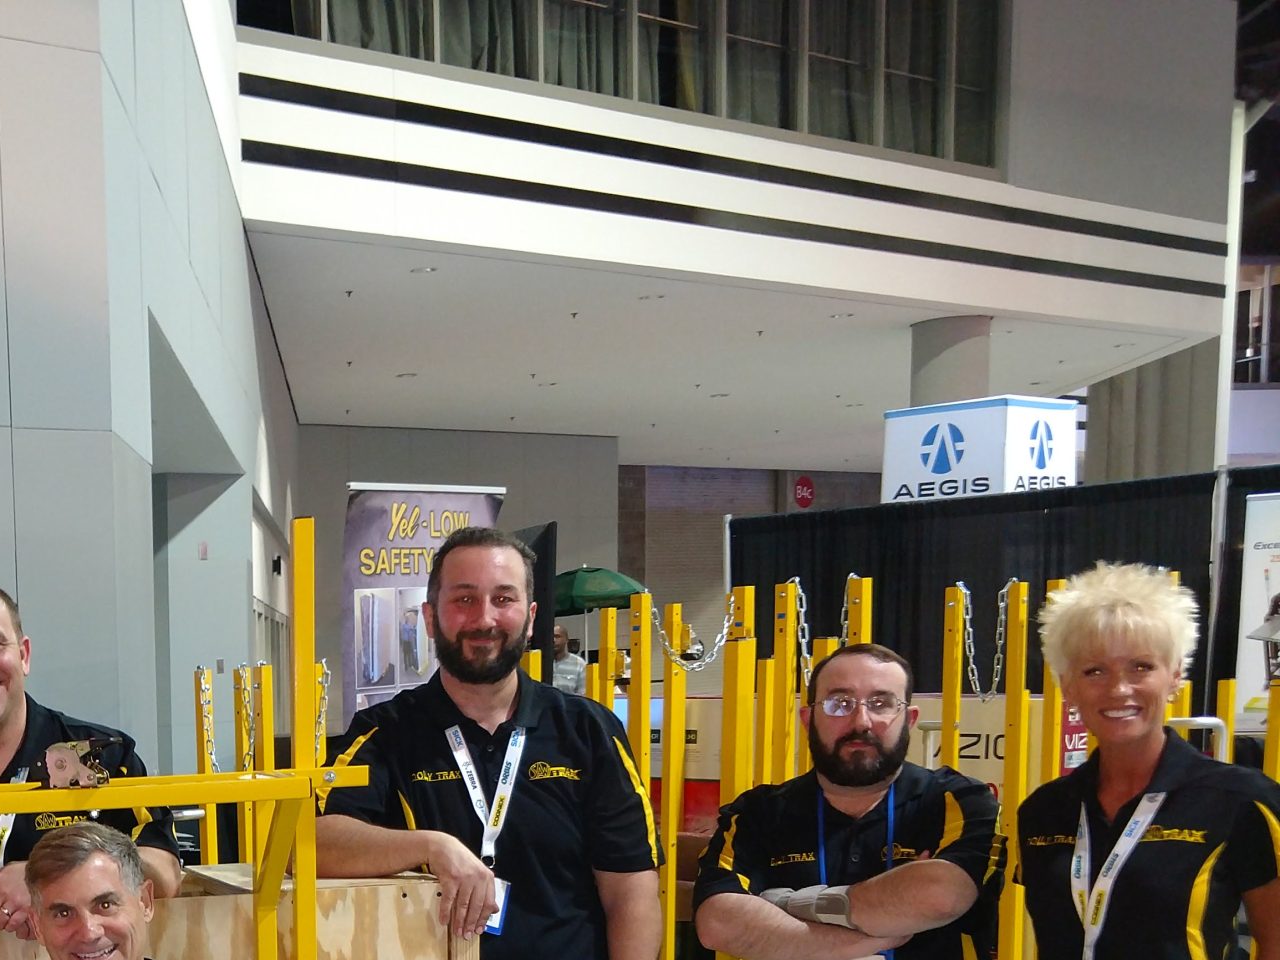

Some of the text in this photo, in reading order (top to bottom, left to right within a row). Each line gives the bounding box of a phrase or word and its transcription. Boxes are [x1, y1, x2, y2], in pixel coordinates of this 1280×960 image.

[893, 477, 990, 499] AEGIS
[1014, 475, 1066, 491] AEGIS
[795, 485, 814, 499] B4c
[360, 546, 434, 575] SAFETY
[1065, 732, 1088, 749] VIZ
